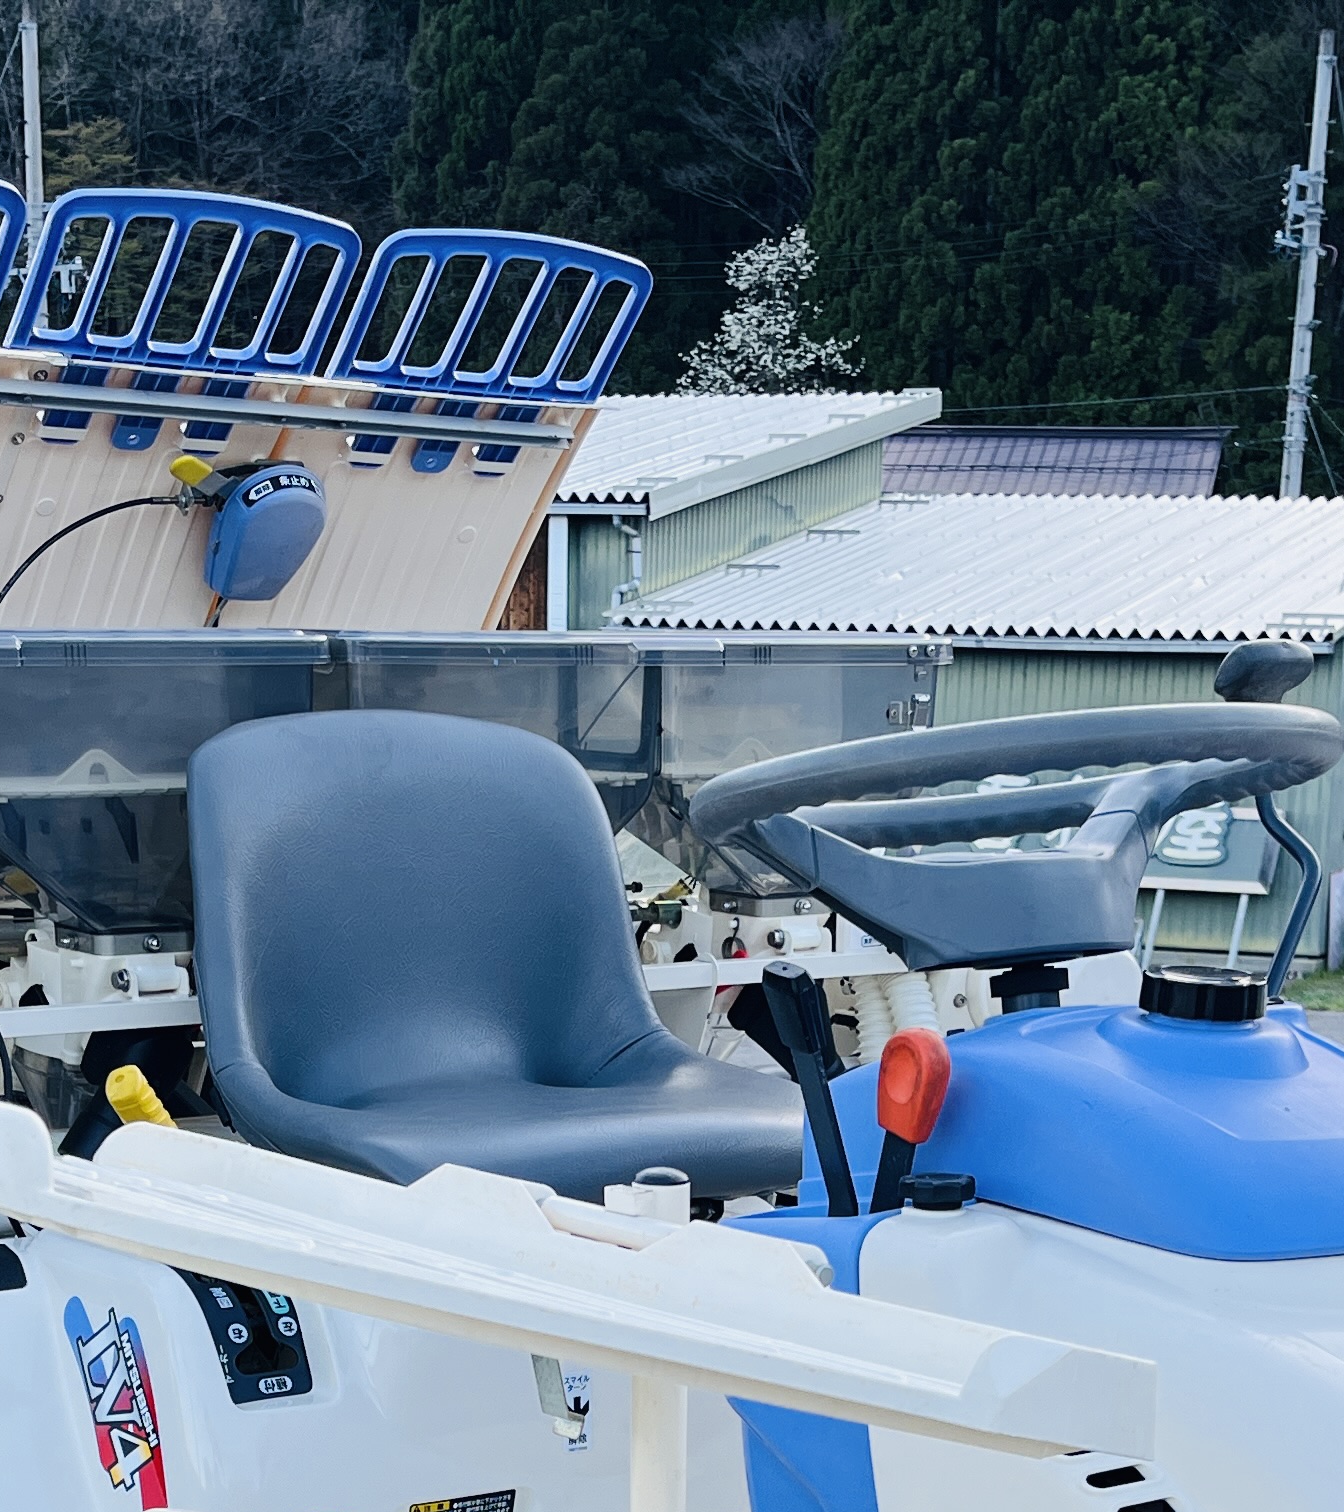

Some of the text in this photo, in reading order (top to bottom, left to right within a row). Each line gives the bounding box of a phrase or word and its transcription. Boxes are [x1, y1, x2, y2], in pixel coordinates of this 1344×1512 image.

[279, 475, 310, 488] 条止め
[231, 1327, 245, 1340] 右
[281, 1321, 295, 1333] 左
[263, 1377, 288, 1393] 植付
[564, 1375, 590, 1385] スマイル
[121, 1330, 160, 1448] MITSUBISHI
[567, 1384, 587, 1393] ターン
